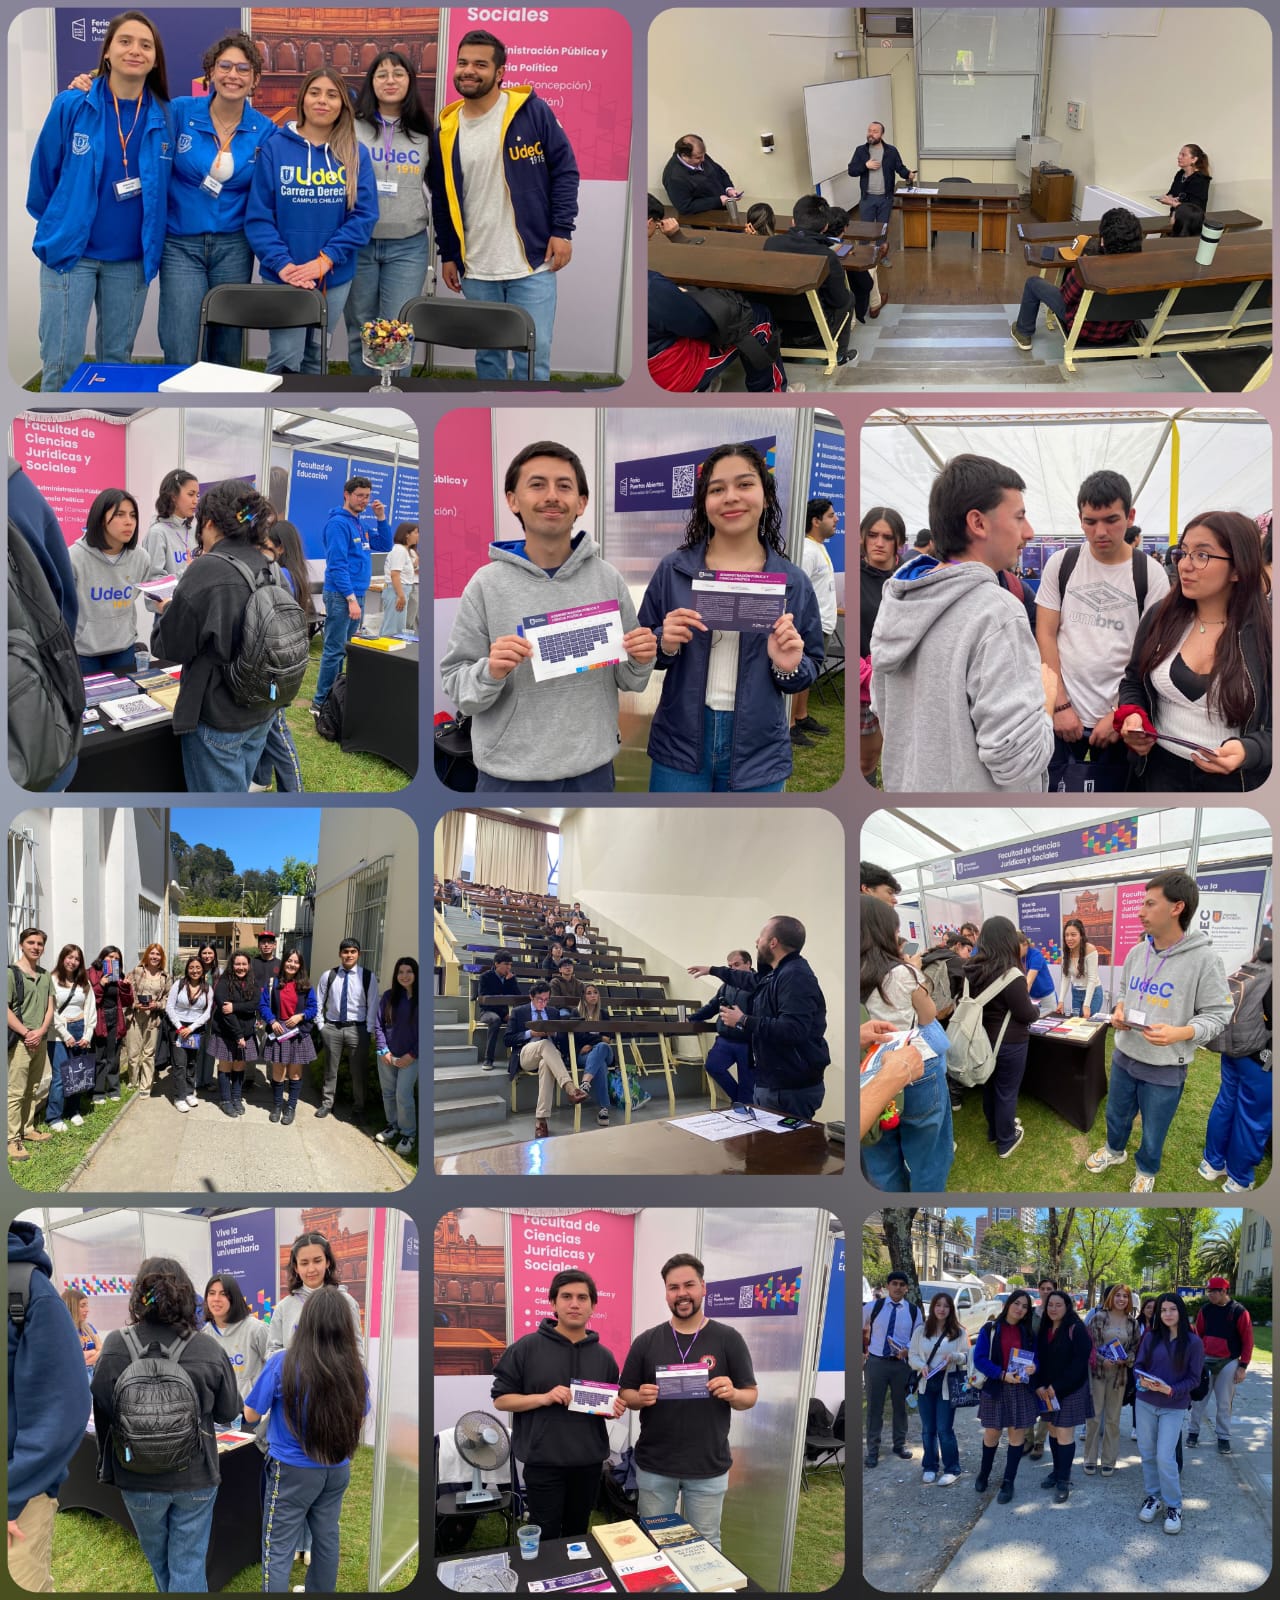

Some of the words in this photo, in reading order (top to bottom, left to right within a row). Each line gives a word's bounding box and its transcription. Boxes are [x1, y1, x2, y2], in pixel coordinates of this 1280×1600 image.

[467, 7, 550, 22] Sociales
[504, 46, 559, 56] inistración
[561, 47, 600, 56] Pública
[601, 49, 608, 58] y
[519, 63, 558, 73] Política
[523, 78, 592, 92] (Concepción)
[371, 147, 421, 164] UdeC
[509, 141, 543, 160] UdeC
[280, 185, 315, 197] Carrera
[24, 419, 79, 436] Facultad
[81, 428, 96, 439] de
[25, 433, 79, 449] Ciencias
[26, 446, 82, 462] Jurídicas
[84, 455, 92, 466] y
[26, 459, 77, 474] Sociales
[297, 460, 325, 471] Facultad
[296, 469, 328, 481] Educación
[462, 478, 468, 487] y
[433, 506, 457, 517] ción)
[90, 585, 132, 600] UdeC
[1070, 611, 1124, 631] umbro
[998, 849, 1023, 860] Facultad
[1032, 840, 1061, 852] Ciencias
[1031, 851, 1059, 861] Sociales
[1129, 976, 1174, 998] UdeC
[523, 1214, 582, 1231] Facultad
[584, 1220, 601, 1233] de
[215, 1228, 230, 1238] Vive
[230, 1226, 238, 1235] la
[523, 1229, 581, 1245] Ciencias
[216, 1233, 254, 1248] experiencia
[216, 1242, 260, 1257] universitaria
[524, 1244, 585, 1260] Jurídicas
[587, 1251, 595, 1264] y
